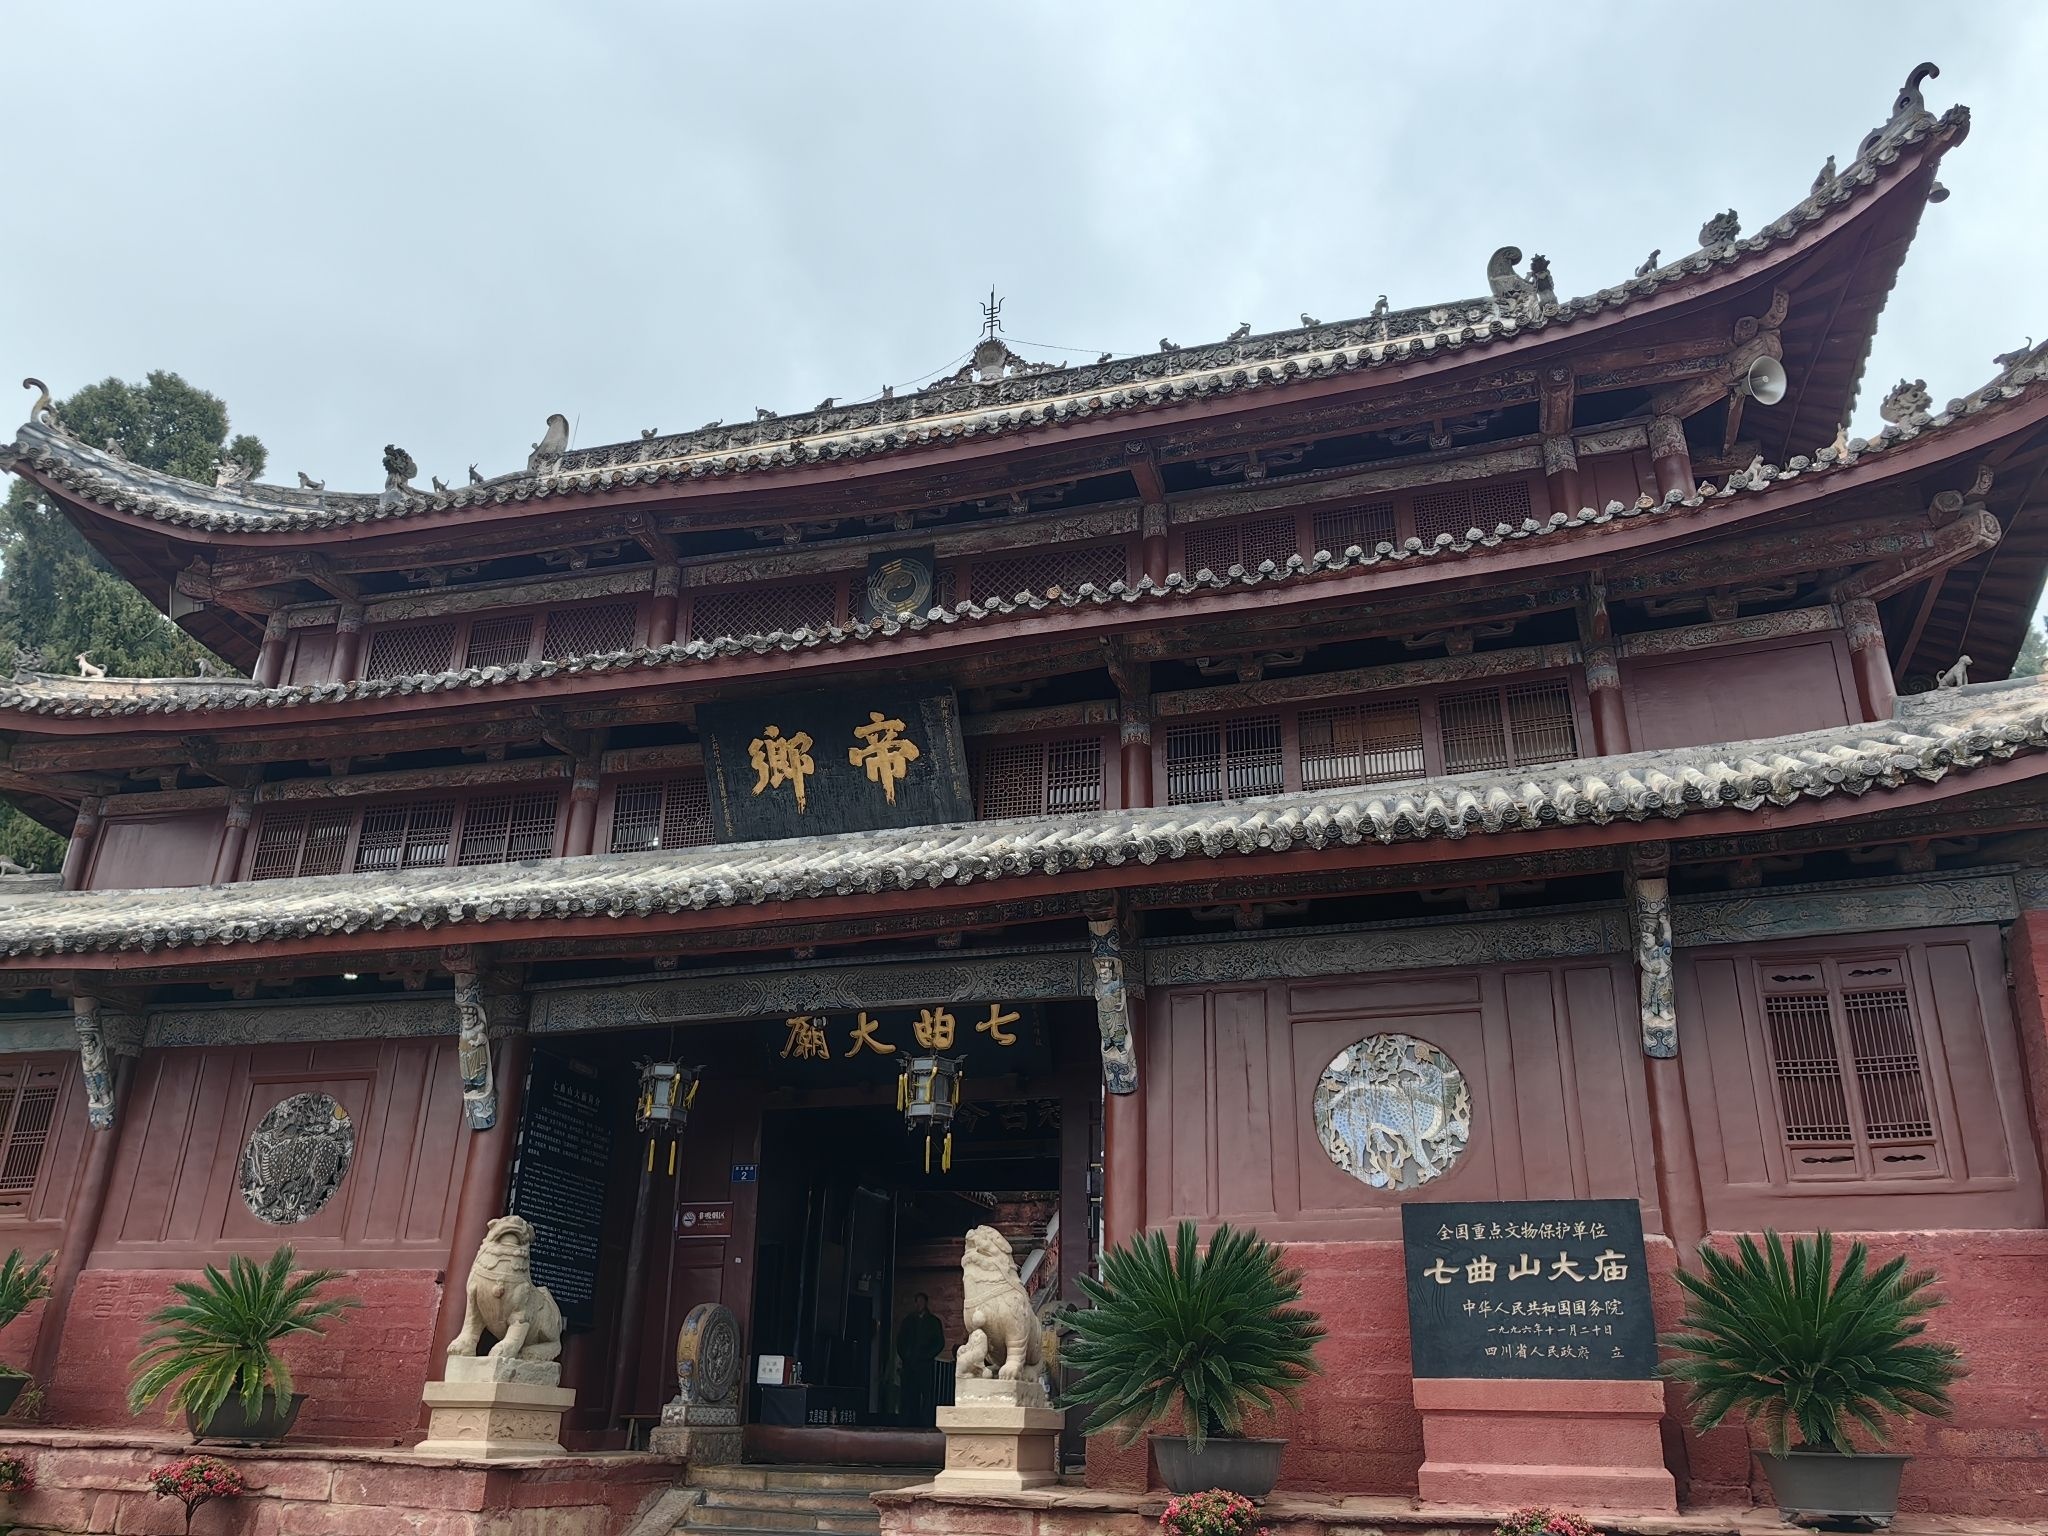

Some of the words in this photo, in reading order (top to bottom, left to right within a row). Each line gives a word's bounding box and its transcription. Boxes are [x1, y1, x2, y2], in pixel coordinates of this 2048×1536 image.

[741, 1171, 748, 1180] 2
[1436, 1222, 1609, 1241] 全国重点文物保护单位
[1423, 1249, 1629, 1285] 七曲山大庙
[1462, 1299, 1624, 1318] 中华人民共和国国务院
[1487, 1323, 1613, 1337] 一九九六年十一月二十日
[1484, 1343, 1590, 1360] 四川省人民政府
[1610, 1346, 1625, 1359] 立
